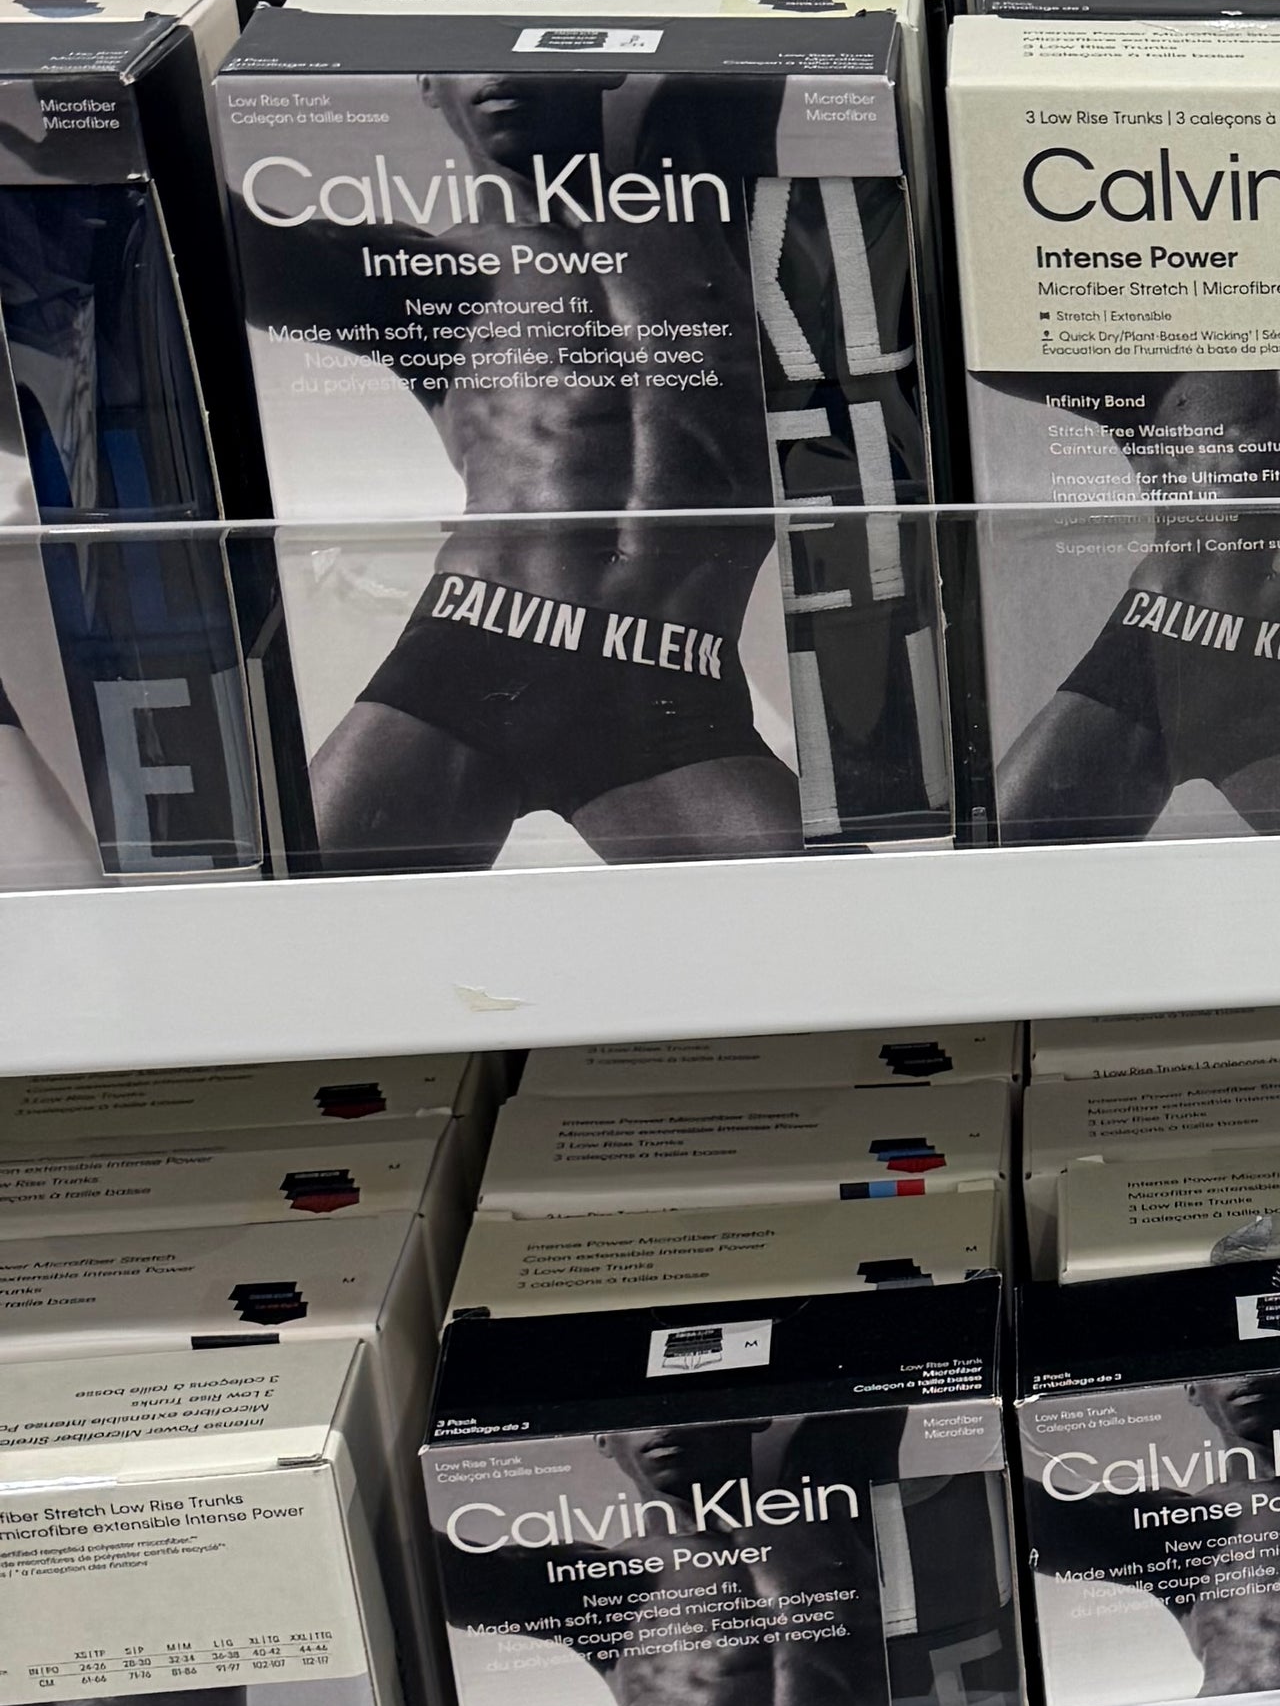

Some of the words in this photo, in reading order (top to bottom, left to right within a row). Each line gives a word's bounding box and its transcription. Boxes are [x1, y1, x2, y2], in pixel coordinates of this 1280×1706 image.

[1026, 110, 1035, 124] 3
[1040, 111, 1072, 124] Low
[1077, 111, 1108, 124] Rise
[1113, 111, 1163, 124] Trunks
[1176, 111, 1185, 124] 3
[1190, 112, 1261, 129] caleçons
[1266, 112, 1276, 125] à
[242, 155, 517, 227] Calvin
[533, 153, 730, 225] Klein
[362, 246, 501, 277] Intense
[511, 244, 629, 275] Power
[1036, 245, 1143, 269] Intense
[1150, 245, 1239, 269] Power
[1039, 282, 1125, 295] Microfiber
[1130, 282, 1188, 295] Stretch
[406, 299, 452, 315] New
[458, 297, 562, 315] contoured
[569, 297, 593, 313] fit.
[269, 325, 331, 341] Made
[336, 324, 379, 340] with
[385, 323, 427, 341] soft,
[432, 320, 522, 343] recycled
[527, 320, 632, 337] microfiber
[636, 319, 733, 342] polyester.
[432, 576, 586, 650] CALVIN
[603, 614, 722, 679] KLEIN
[1041, 1440, 1257, 1501] Calvin
[44, 1505, 106, 1520] Stretch
[111, 1503, 144, 1514] Low
[150, 1500, 183, 1512] Rise
[188, 1494, 243, 1508] Trunks
[447, 1493, 677, 1553] Calvin
[692, 1476, 858, 1531] Klein
